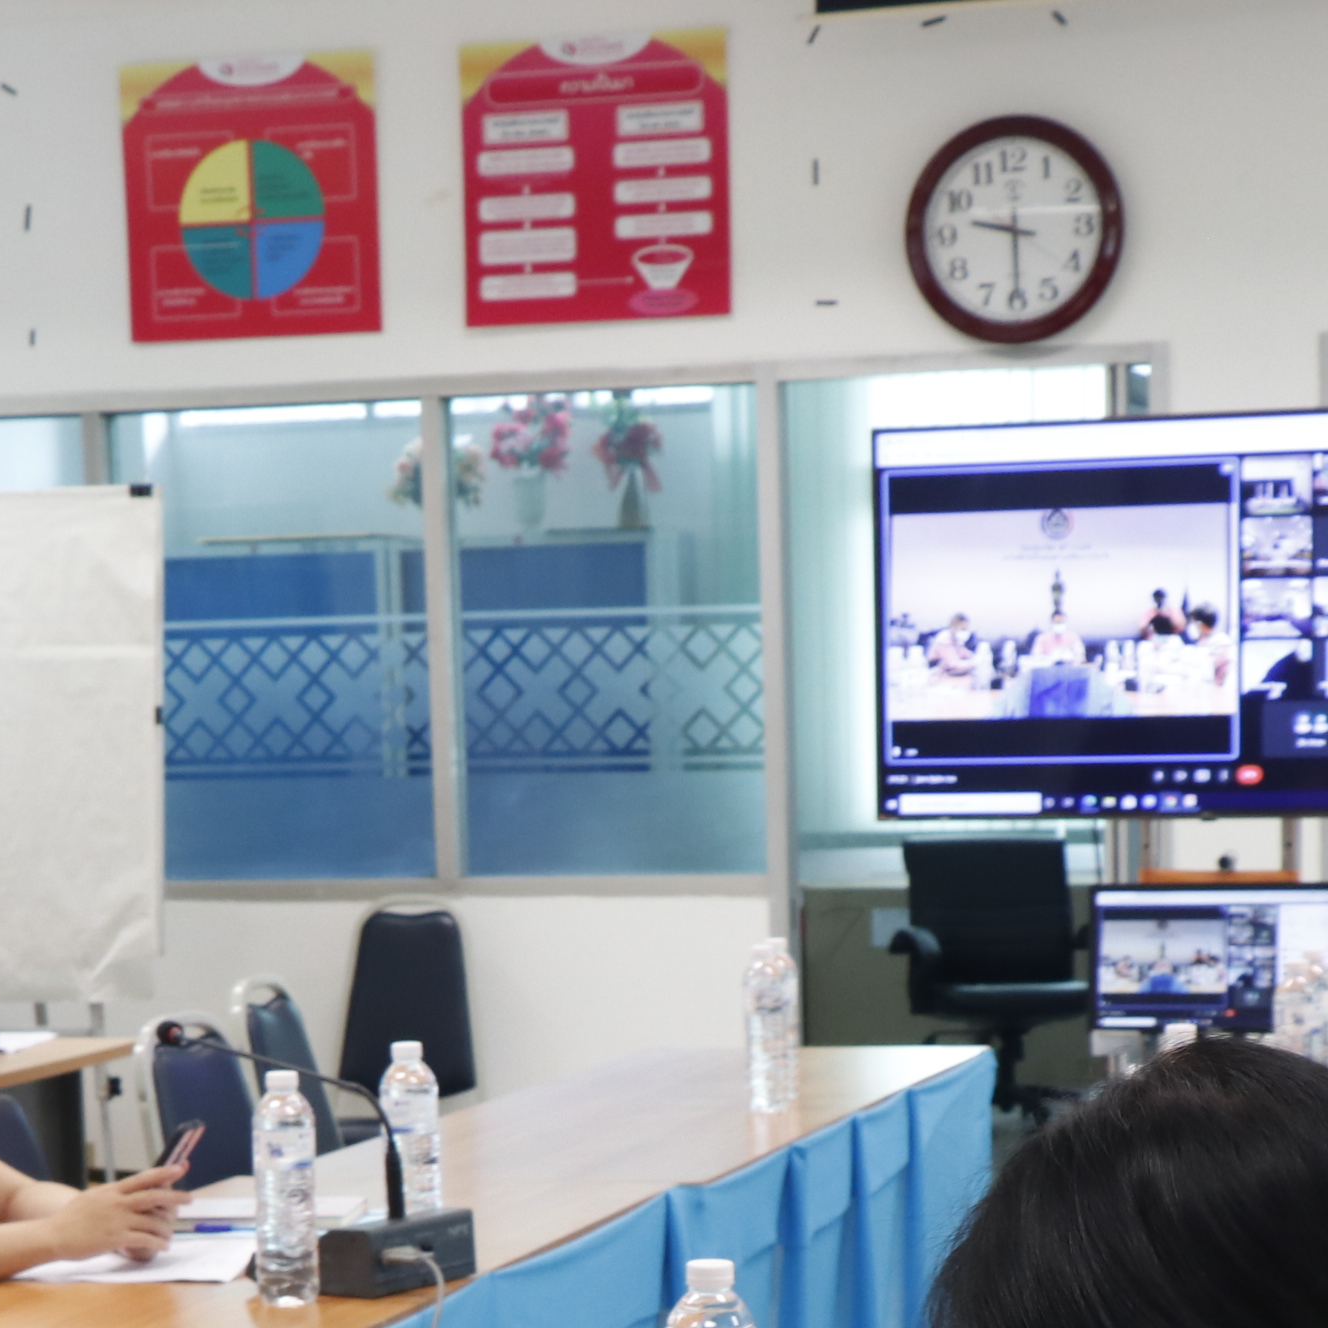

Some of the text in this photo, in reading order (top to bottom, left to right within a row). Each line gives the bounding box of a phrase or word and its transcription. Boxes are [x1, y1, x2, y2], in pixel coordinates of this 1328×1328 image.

[1001, 148, 1027, 173] 12
[974, 161, 993, 185] 11
[948, 188, 973, 213] 10
[1066, 178, 1083, 203] 2
[938, 224, 958, 247] 9
[1075, 213, 1094, 236] 3
[949, 257, 969, 281] 8
[1064, 249, 1080, 273] 4
[979, 281, 997, 307] 7
[1008, 287, 1028, 311] 6
[1038, 276, 1059, 302] 5
